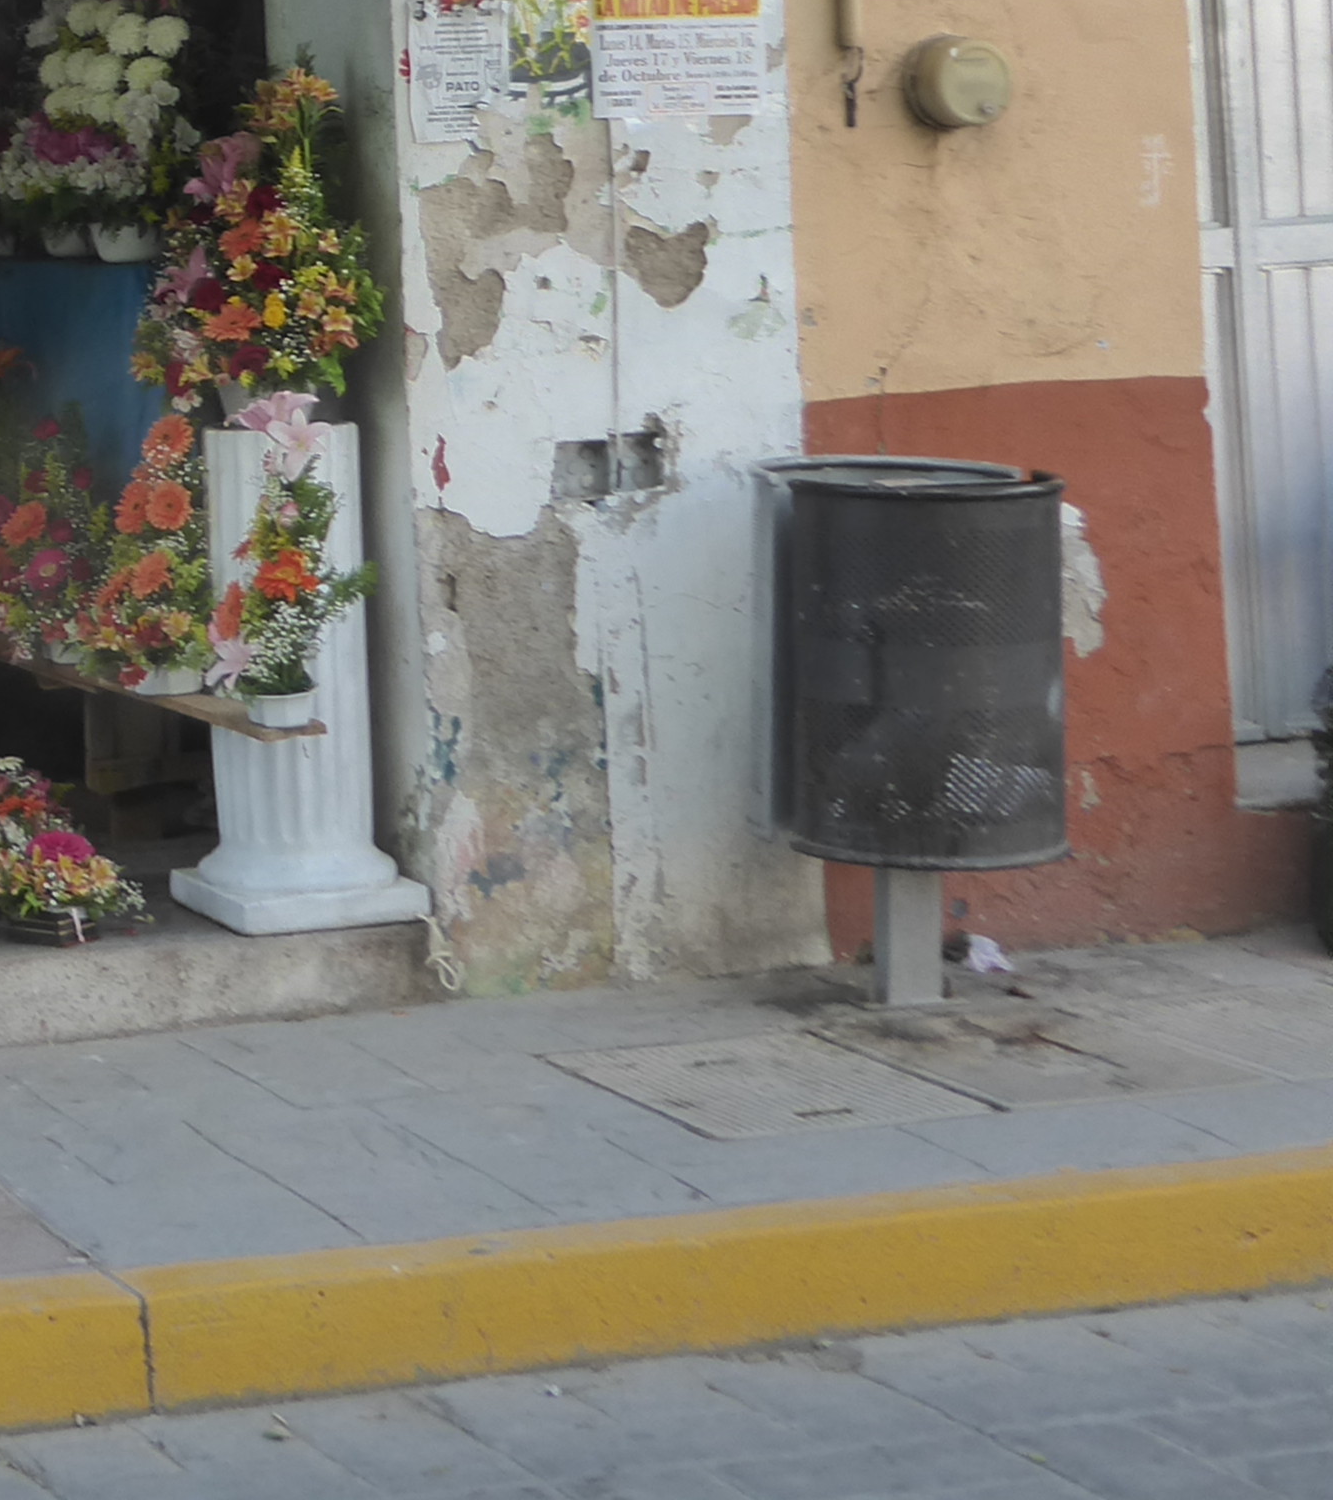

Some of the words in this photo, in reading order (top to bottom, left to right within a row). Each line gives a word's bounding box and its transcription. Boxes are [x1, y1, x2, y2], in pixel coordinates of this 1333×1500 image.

[606, 53, 648, 67] Jueves
[683, 51, 731, 66] Viernes
[598, 70, 617, 83] de
[621, 68, 681, 82] Octubre
[446, 81, 480, 92] PATO
